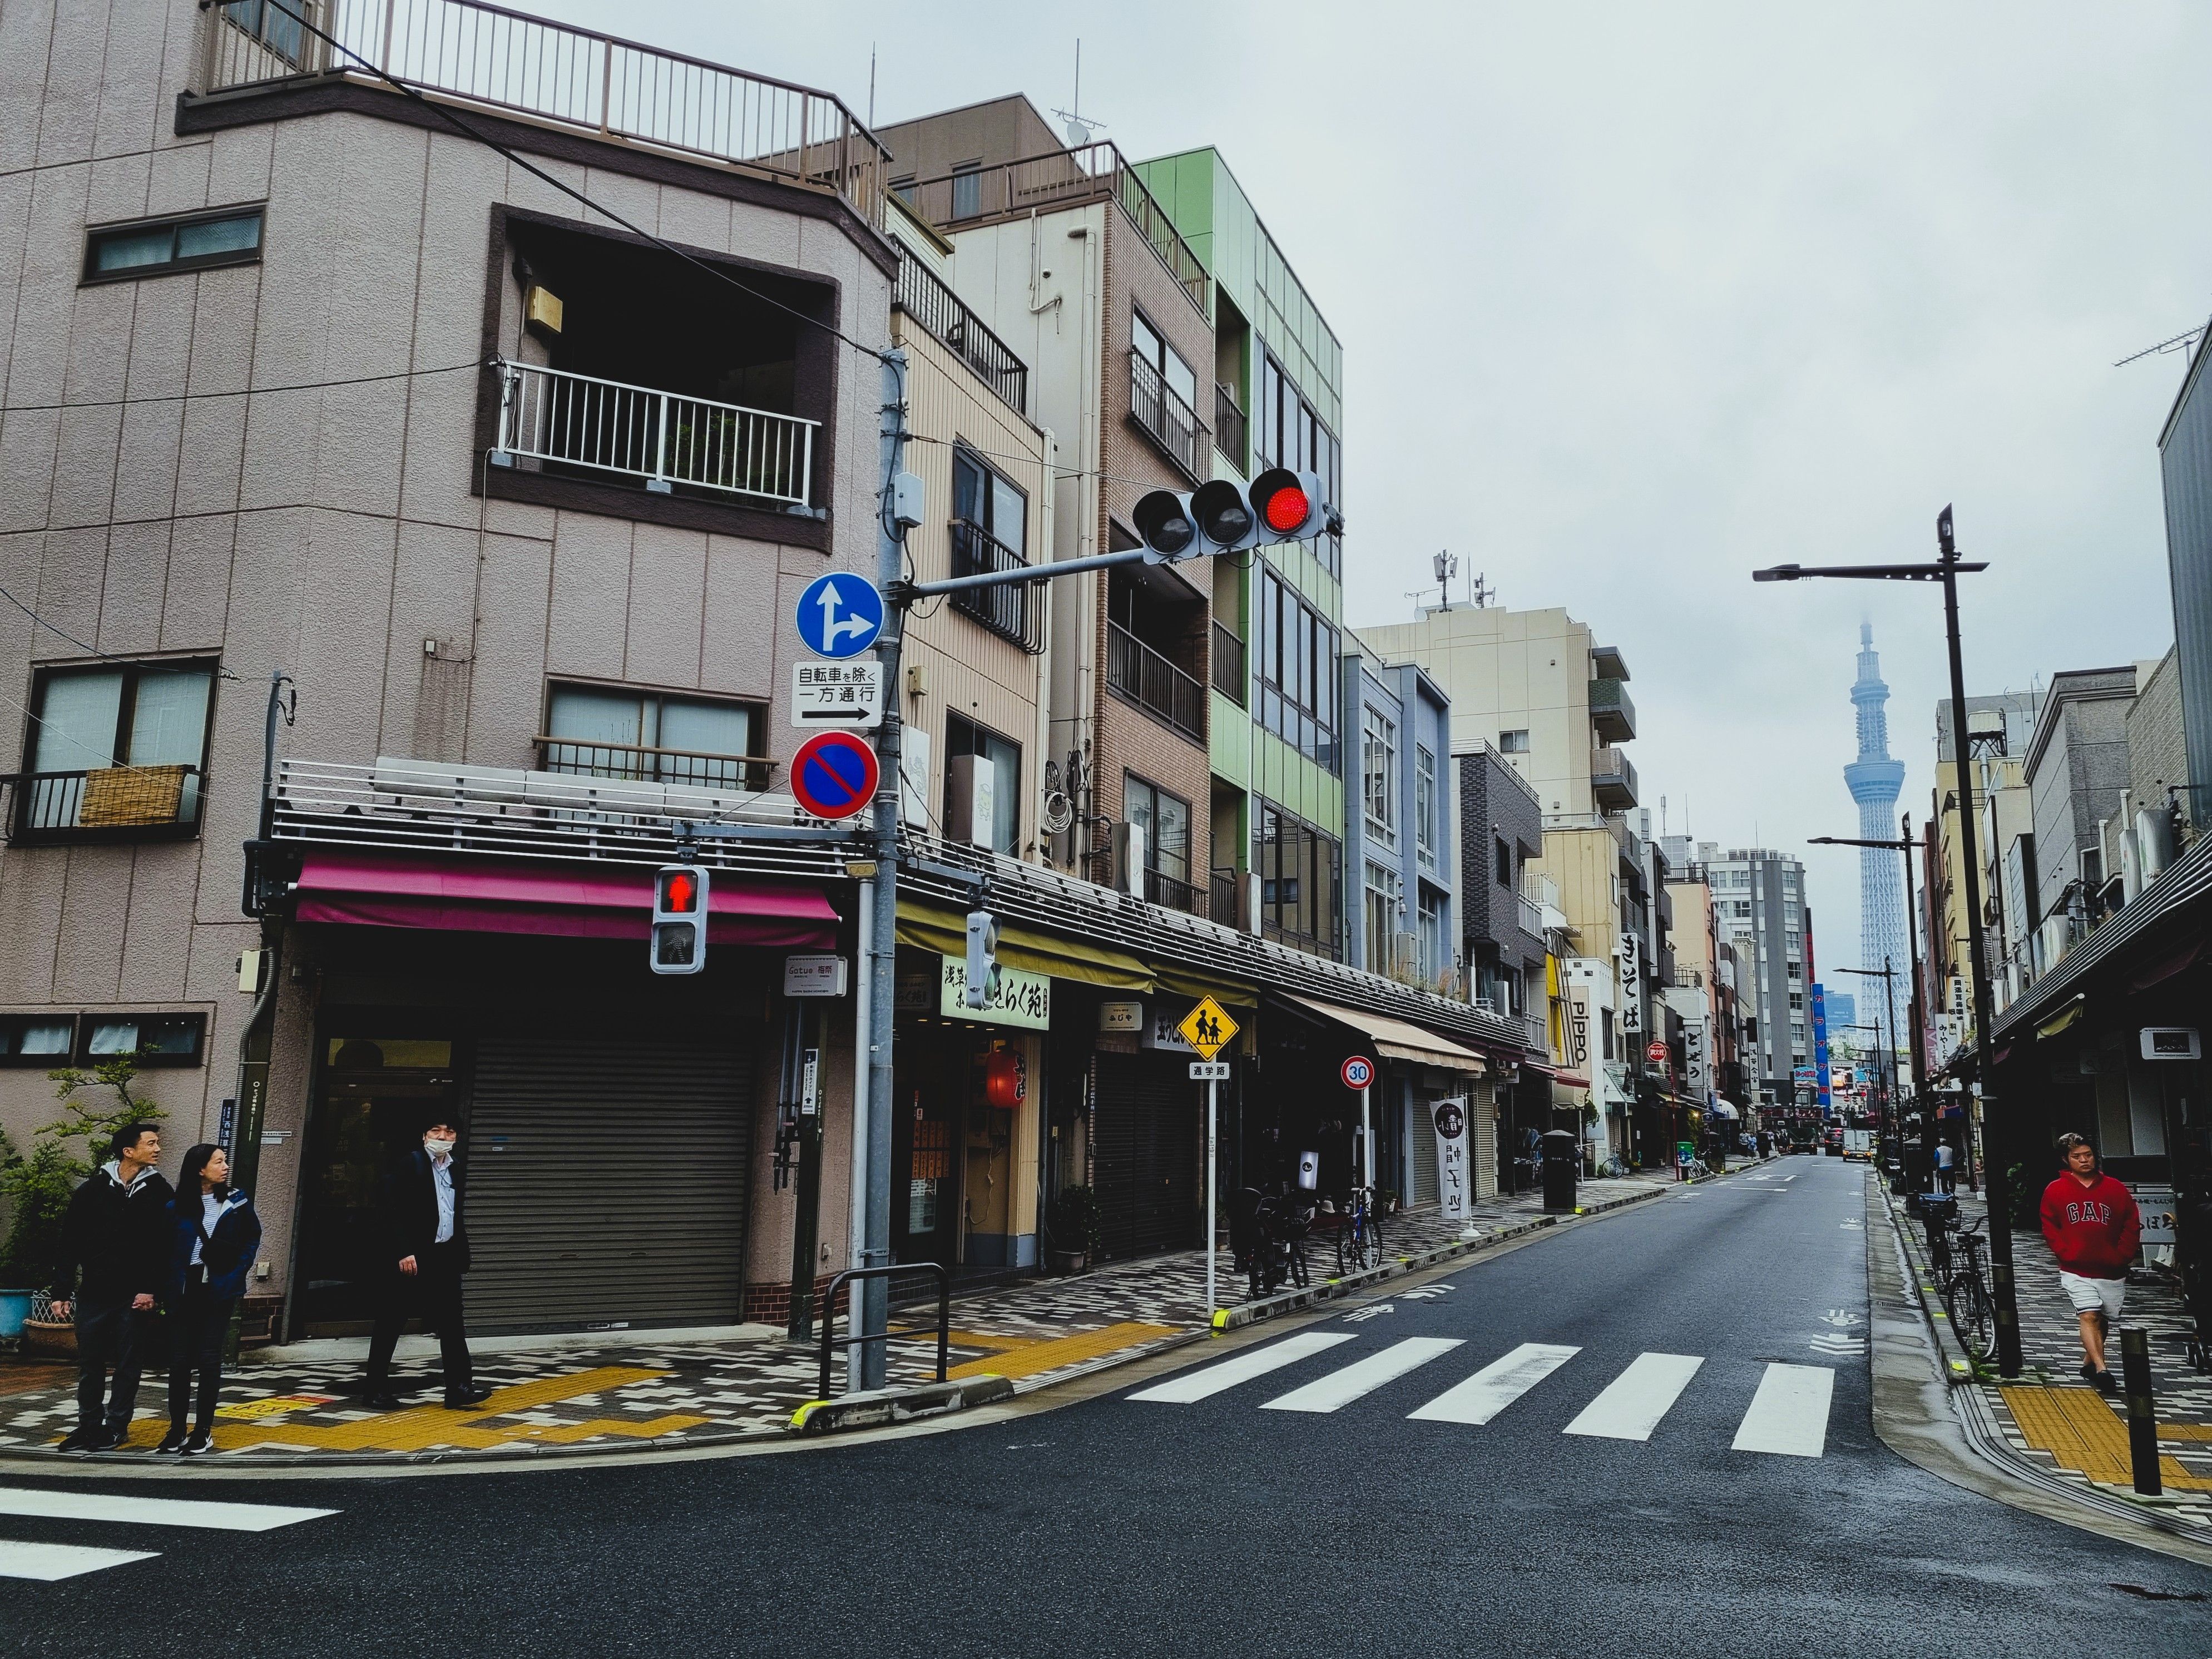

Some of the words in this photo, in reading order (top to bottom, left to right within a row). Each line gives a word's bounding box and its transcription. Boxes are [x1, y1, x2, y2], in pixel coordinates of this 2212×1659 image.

[799, 667, 875, 683] 自転車を除く
[799, 687, 875, 703] 一方通行
[944, 964, 967, 988] 浅草
[1686, 1032, 1702, 1079] どぜう
[1194, 1066, 1225, 1076] 通学路
[1349, 1065, 1367, 1081] 30
[2066, 1201, 2111, 1225] GAP
